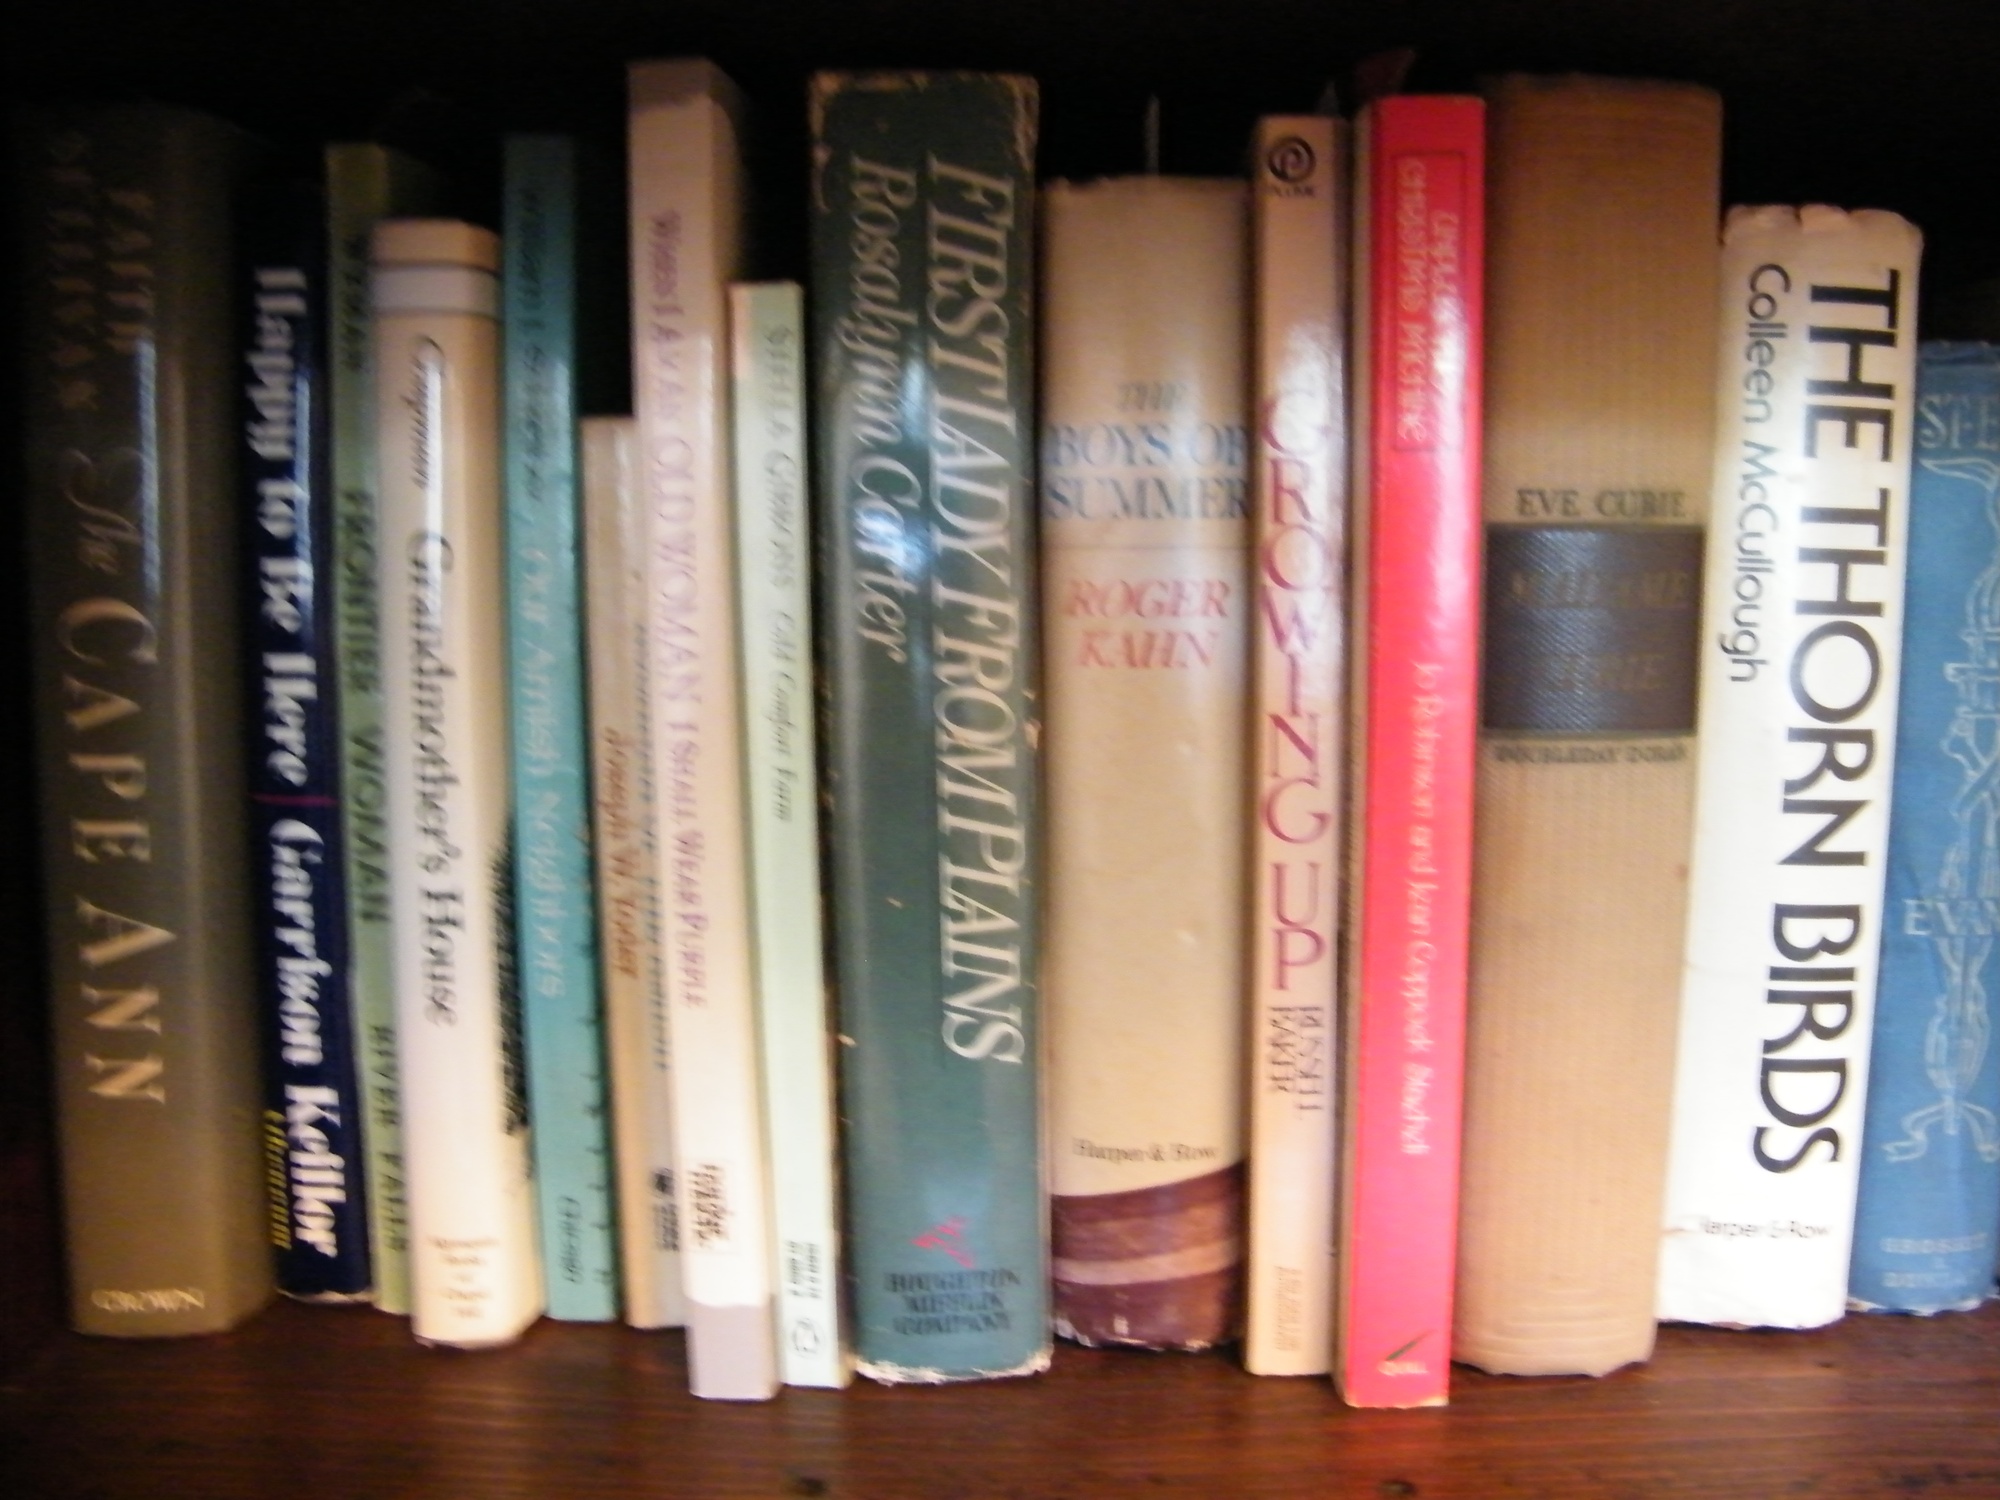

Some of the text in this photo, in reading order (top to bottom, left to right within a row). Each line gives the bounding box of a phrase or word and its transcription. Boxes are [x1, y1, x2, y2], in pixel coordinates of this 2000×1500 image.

[838, 154, 922, 662] Rosalynn Carter
[1045, 423, 1173, 466] BOYS
[247, 265, 318, 789] Happy to Be Here
[652, 435, 698, 526] OLD
[1043, 475, 1248, 521] SUMMER
[1515, 487, 1687, 518] EVE CURIE
[1717, 262, 1791, 684] Colleen McCullough
[656, 529, 704, 701] WOMAN
[926, 151, 1027, 1067] FIRST LADY FROM PLAINS
[1062, 578, 1231, 618] ROGER
[1077, 629, 1218, 669] KAHN
[408, 529, 468, 1029] Grandmother's House
[1752, 267, 1900, 1175] THE THORN BIRDS
[56, 596, 180, 1105] CAPE ANN
[347, 725, 392, 926] WOMAN
[770, 764, 799, 824] Farm
[1408, 824, 1441, 874] and
[1272, 862, 1328, 990] UP
[268, 819, 347, 1259] Garrison Keillor
[1265, 1005, 1299, 1097] BAKER
[1294, 1005, 1326, 1113] RUSSELL
